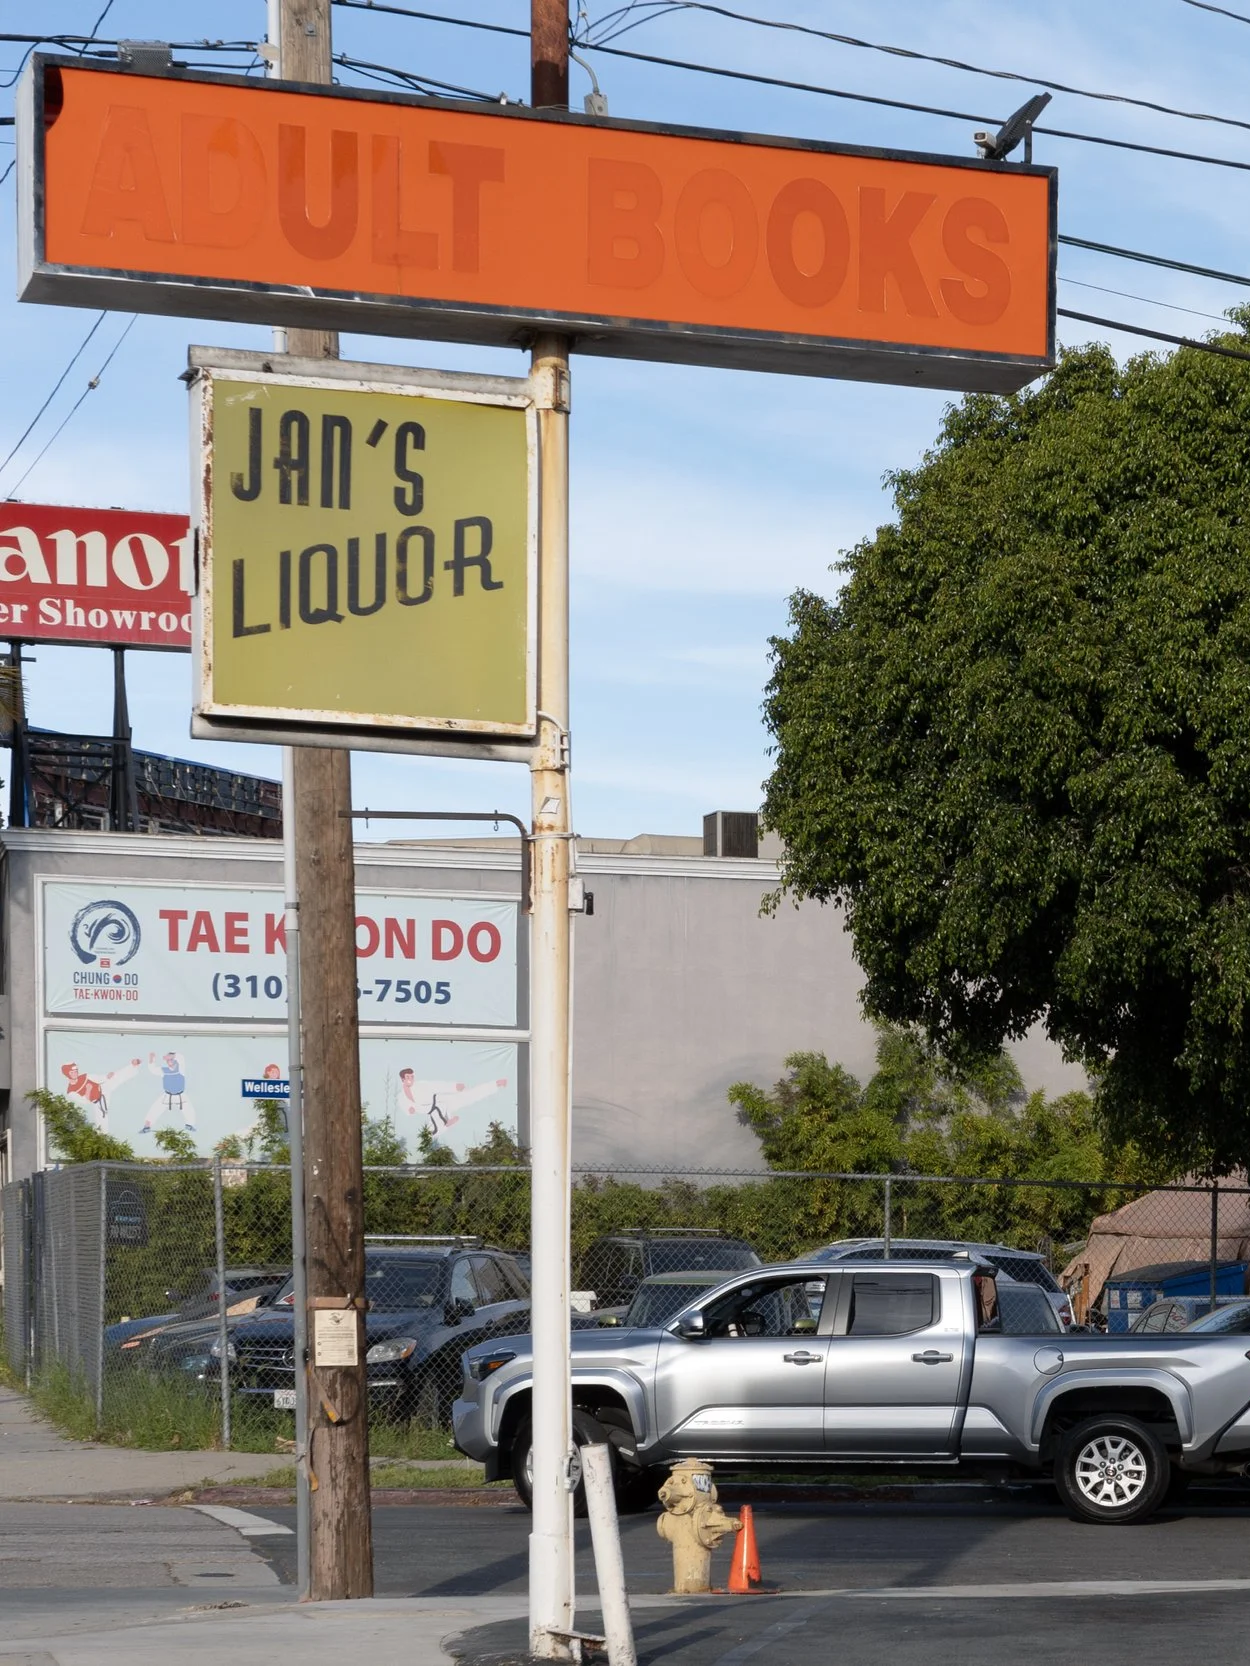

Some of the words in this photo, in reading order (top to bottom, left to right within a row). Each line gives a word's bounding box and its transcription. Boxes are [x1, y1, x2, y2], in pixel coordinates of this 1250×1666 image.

[79, 105, 505, 274] ADULT
[586, 156, 1012, 326] BOOKS
[230, 407, 427, 518] JAN'S
[0, 526, 187, 591] ano
[232, 516, 504, 639] LIQUOR
[159, 909, 250, 954] TAE
[265, 912, 416, 960] KON
[431, 919, 501, 963] DO
[73, 971, 110, 985] CHUNG
[124, 973, 138, 986] DO
[212, 972, 288, 1003] (310
